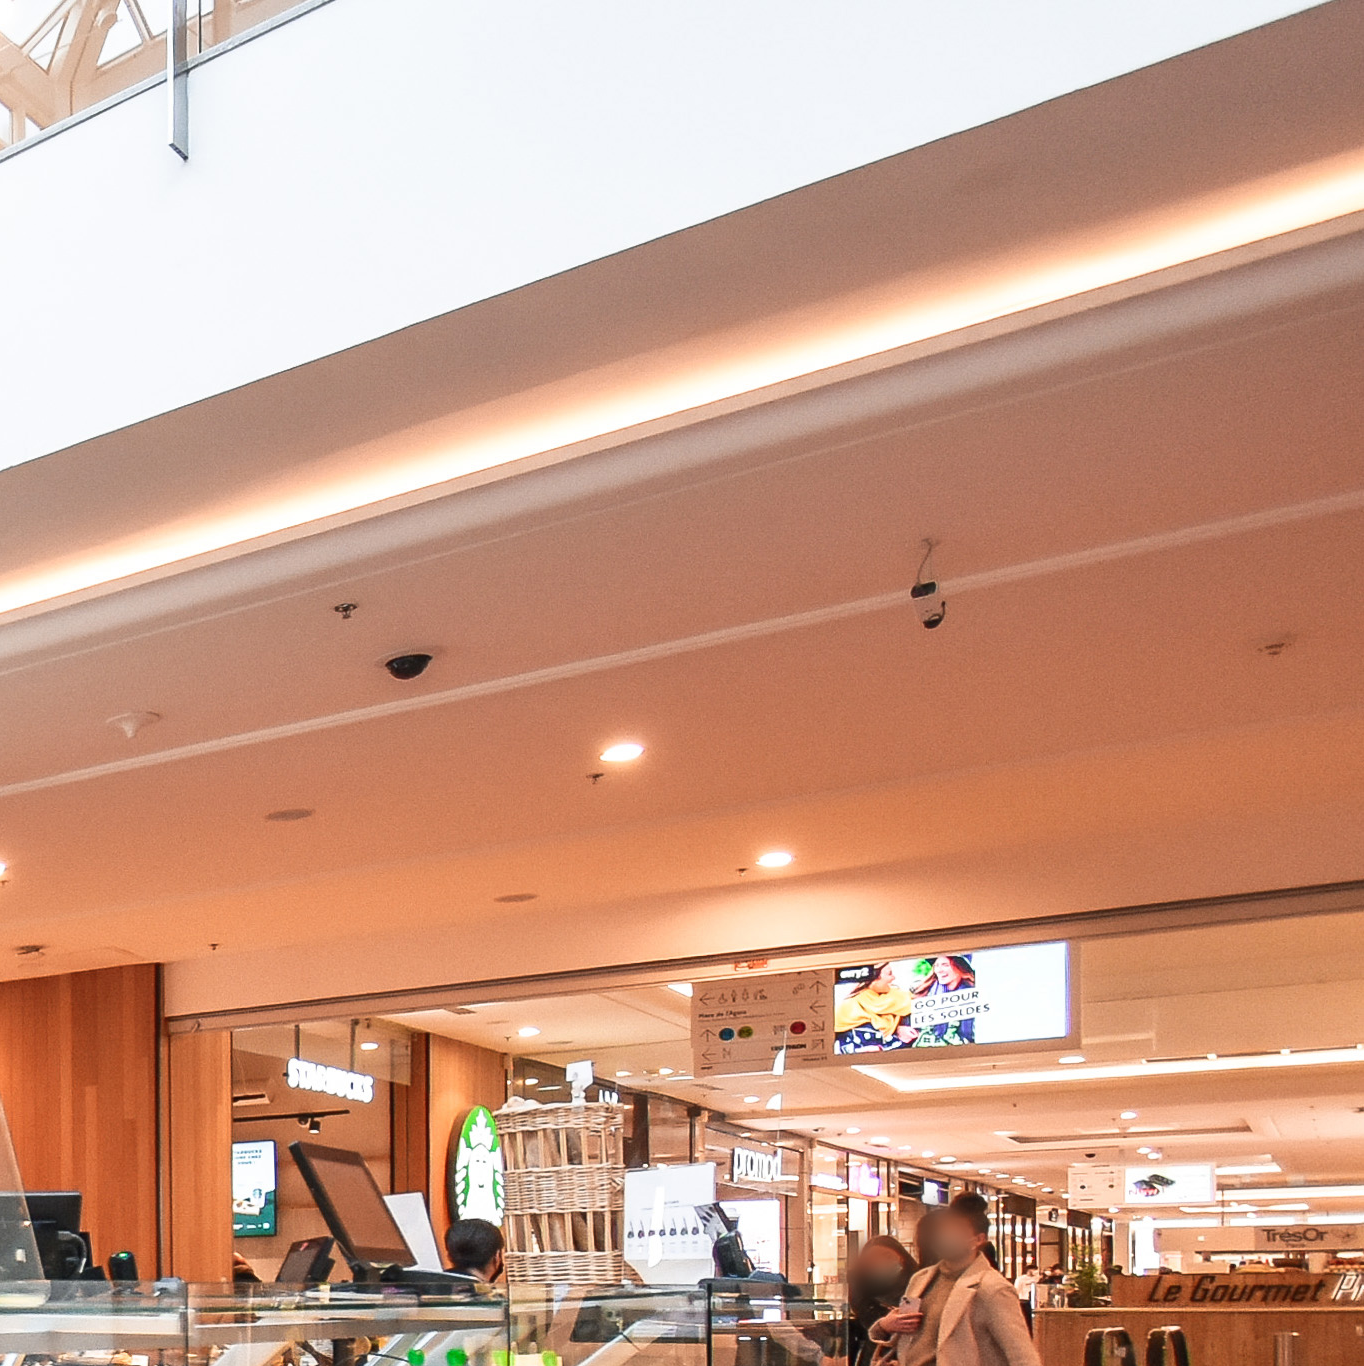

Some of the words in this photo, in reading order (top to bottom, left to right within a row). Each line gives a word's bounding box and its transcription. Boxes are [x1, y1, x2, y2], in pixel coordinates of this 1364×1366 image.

[915, 999, 936, 1010] GO
[941, 991, 979, 1005] POUR
[915, 1015, 934, 1025] LES
[941, 1003, 990, 1020] SOLDES
[733, 1147, 783, 1184] promod
[1147, 1276, 1182, 1303] Le
[1191, 1275, 1327, 1303] Gourmet
